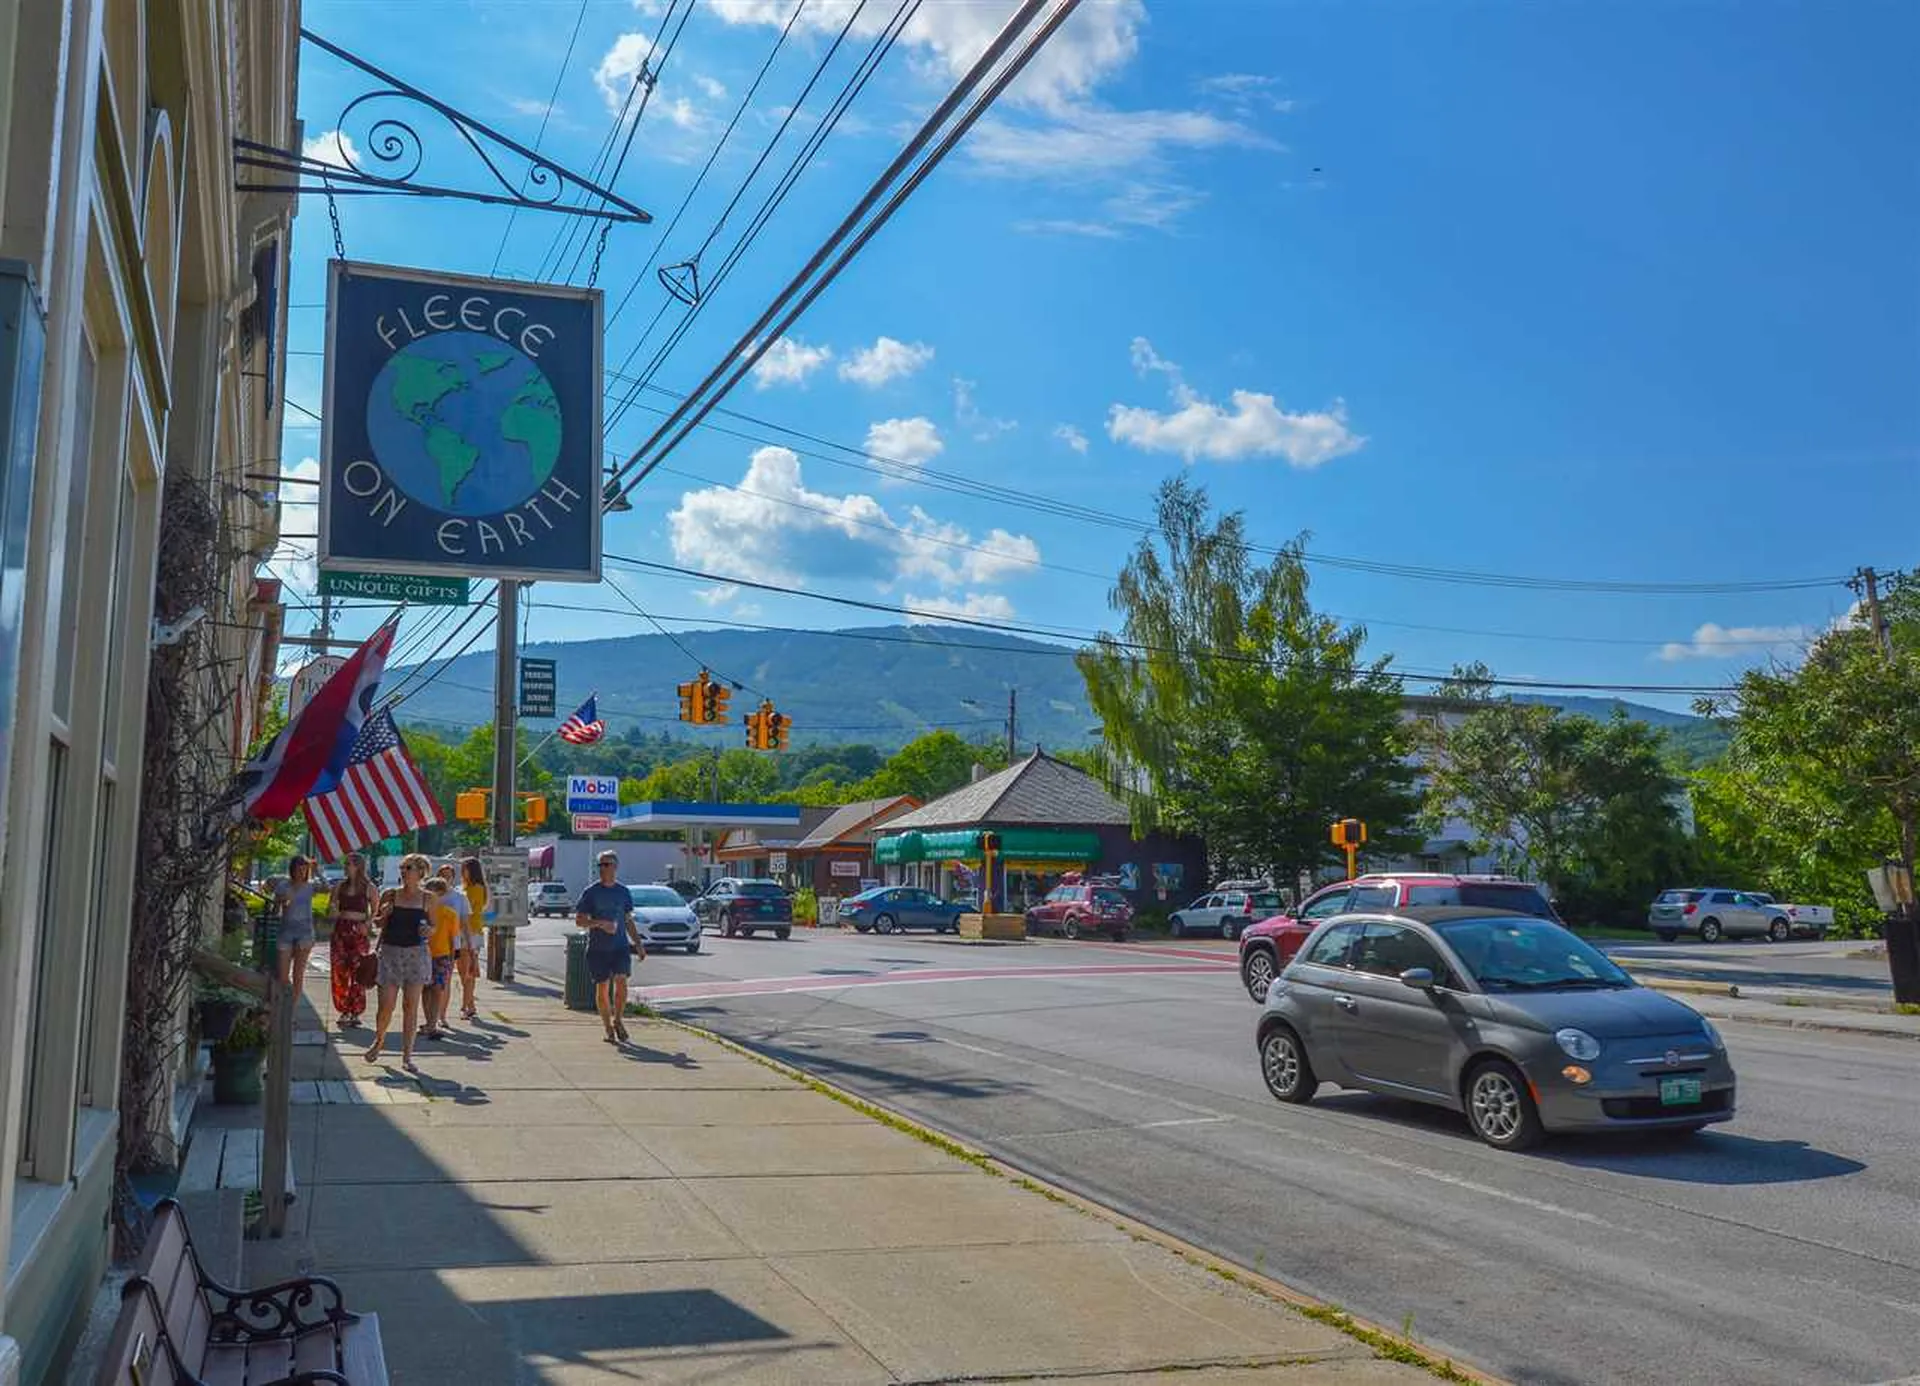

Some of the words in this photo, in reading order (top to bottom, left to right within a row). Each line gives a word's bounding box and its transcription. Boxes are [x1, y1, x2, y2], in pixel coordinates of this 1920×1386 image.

[376, 294, 556, 358] FLEECE
[343, 460, 407, 527] ON
[437, 476, 581, 555] EARTH
[330, 579, 401, 595] UNIQUE
[405, 584, 458, 598] GIFTS
[572, 780, 616, 794] Mobil
